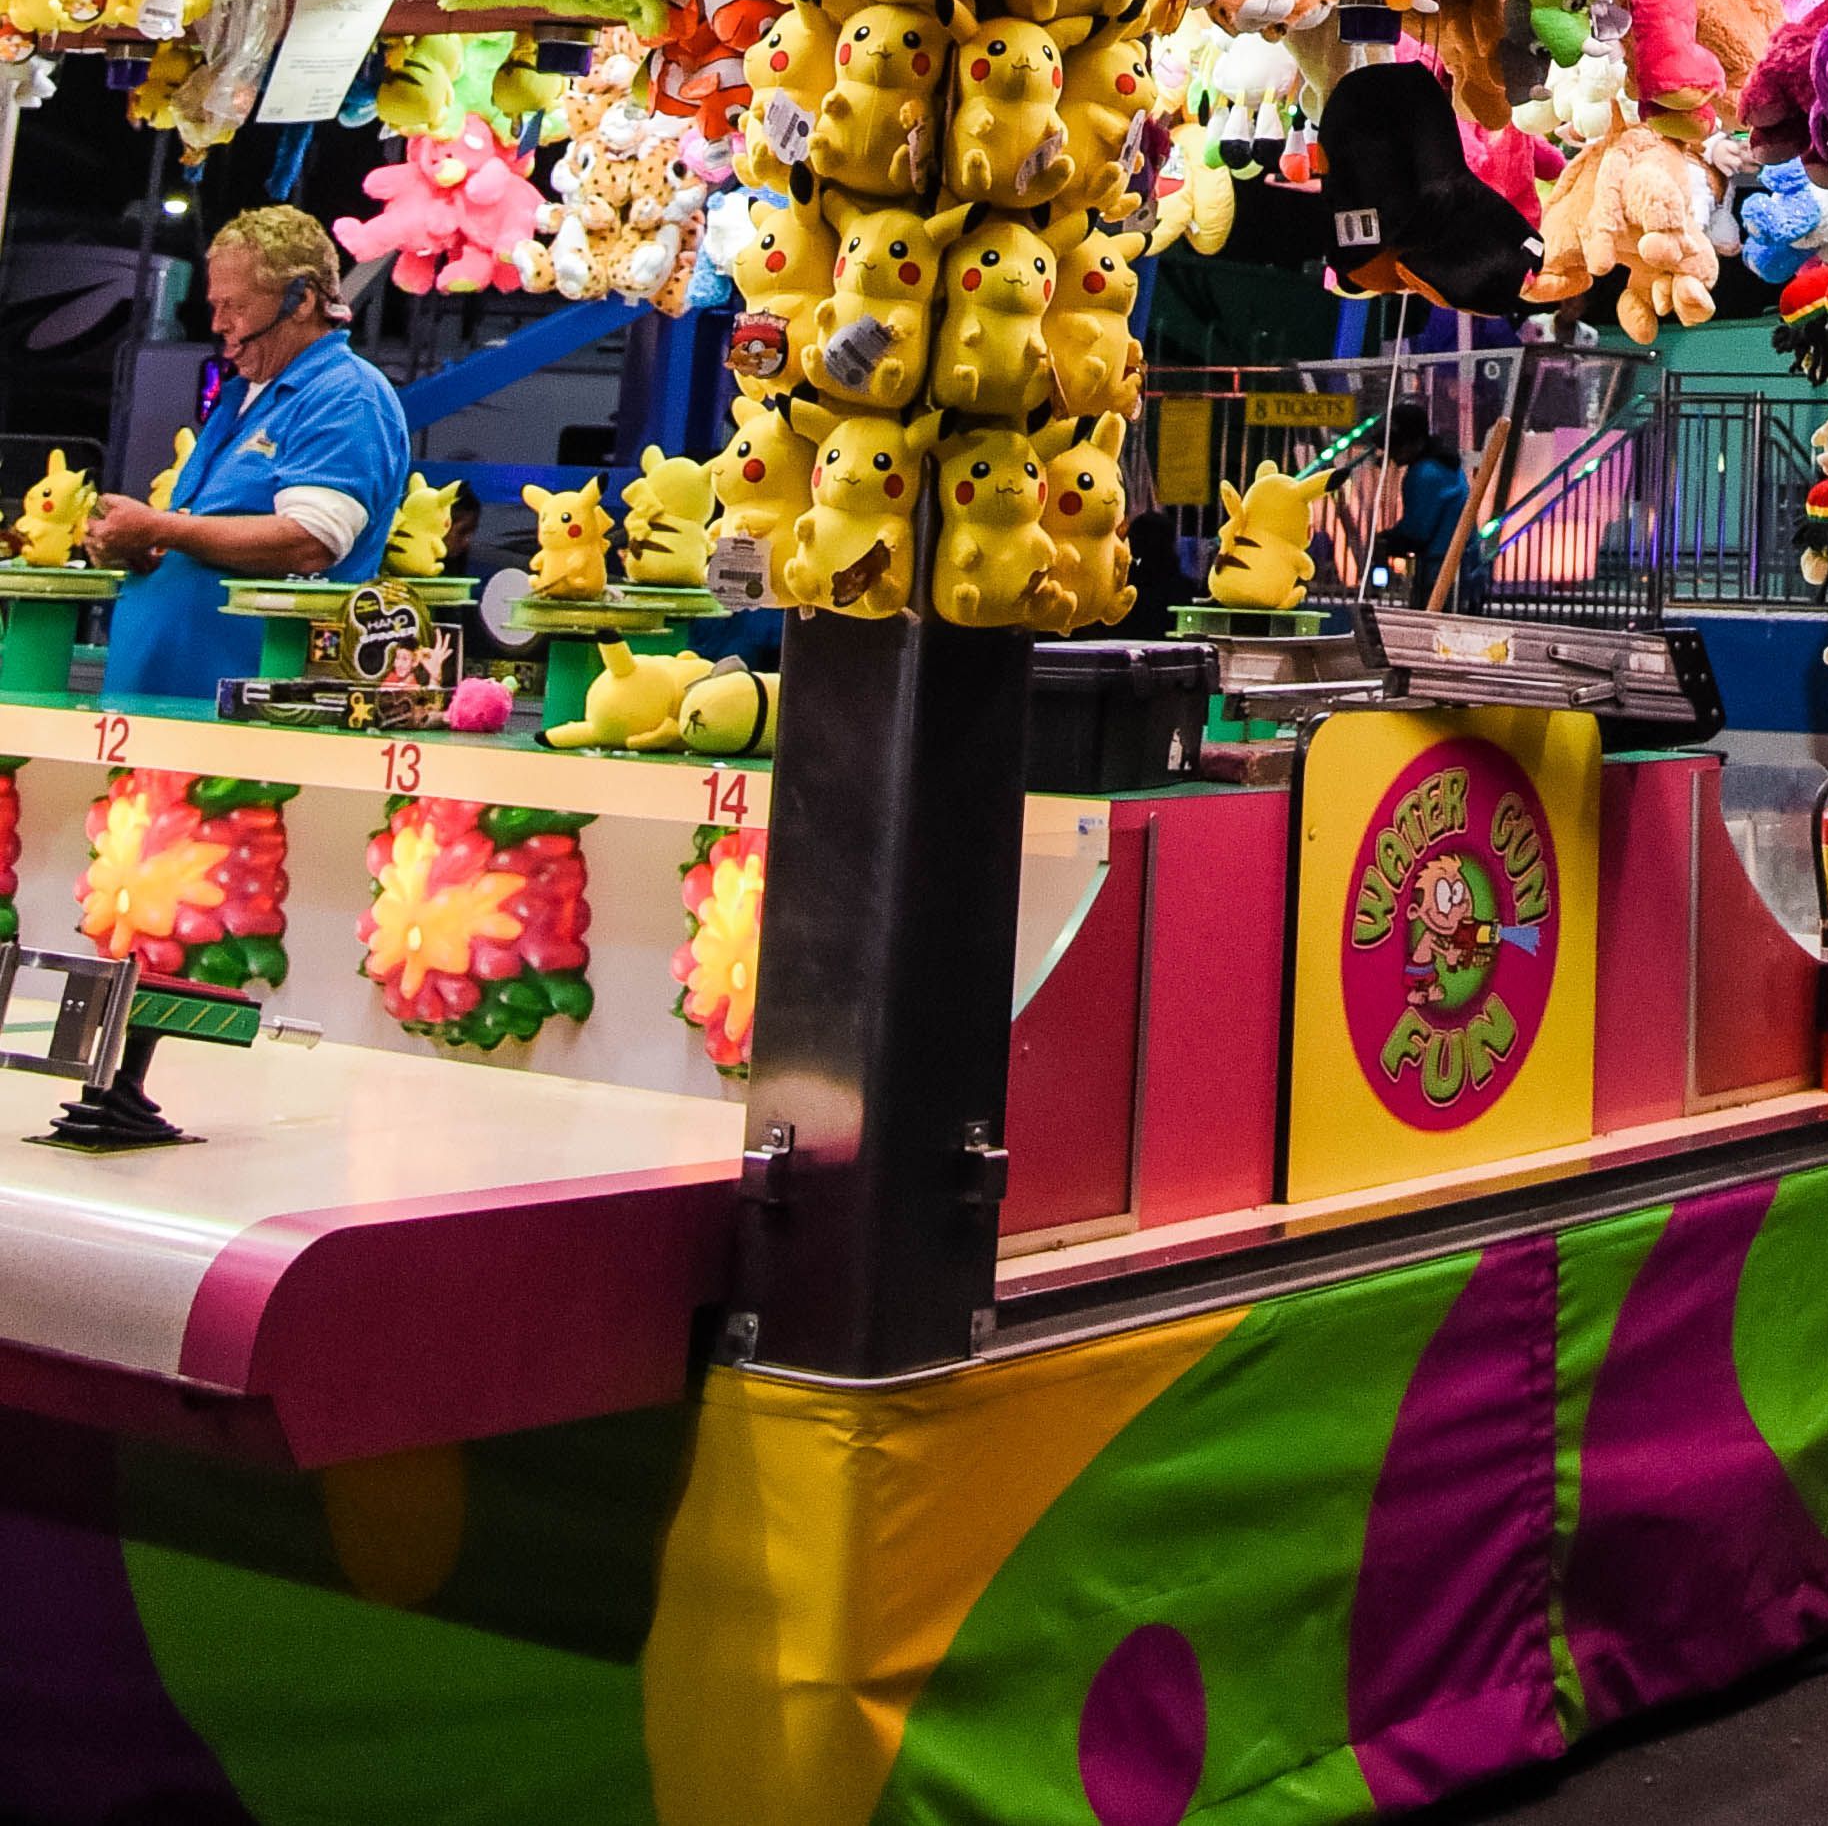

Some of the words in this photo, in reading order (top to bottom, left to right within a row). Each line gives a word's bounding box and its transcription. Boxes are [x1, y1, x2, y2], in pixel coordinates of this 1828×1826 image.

[94, 716, 129, 763] 12
[381, 742, 422, 793] 13
[703, 771, 748, 825] 14
[1351, 766, 1469, 949] WATER
[1490, 791, 1551, 926] GUN
[1379, 992, 1518, 1108] FUN
